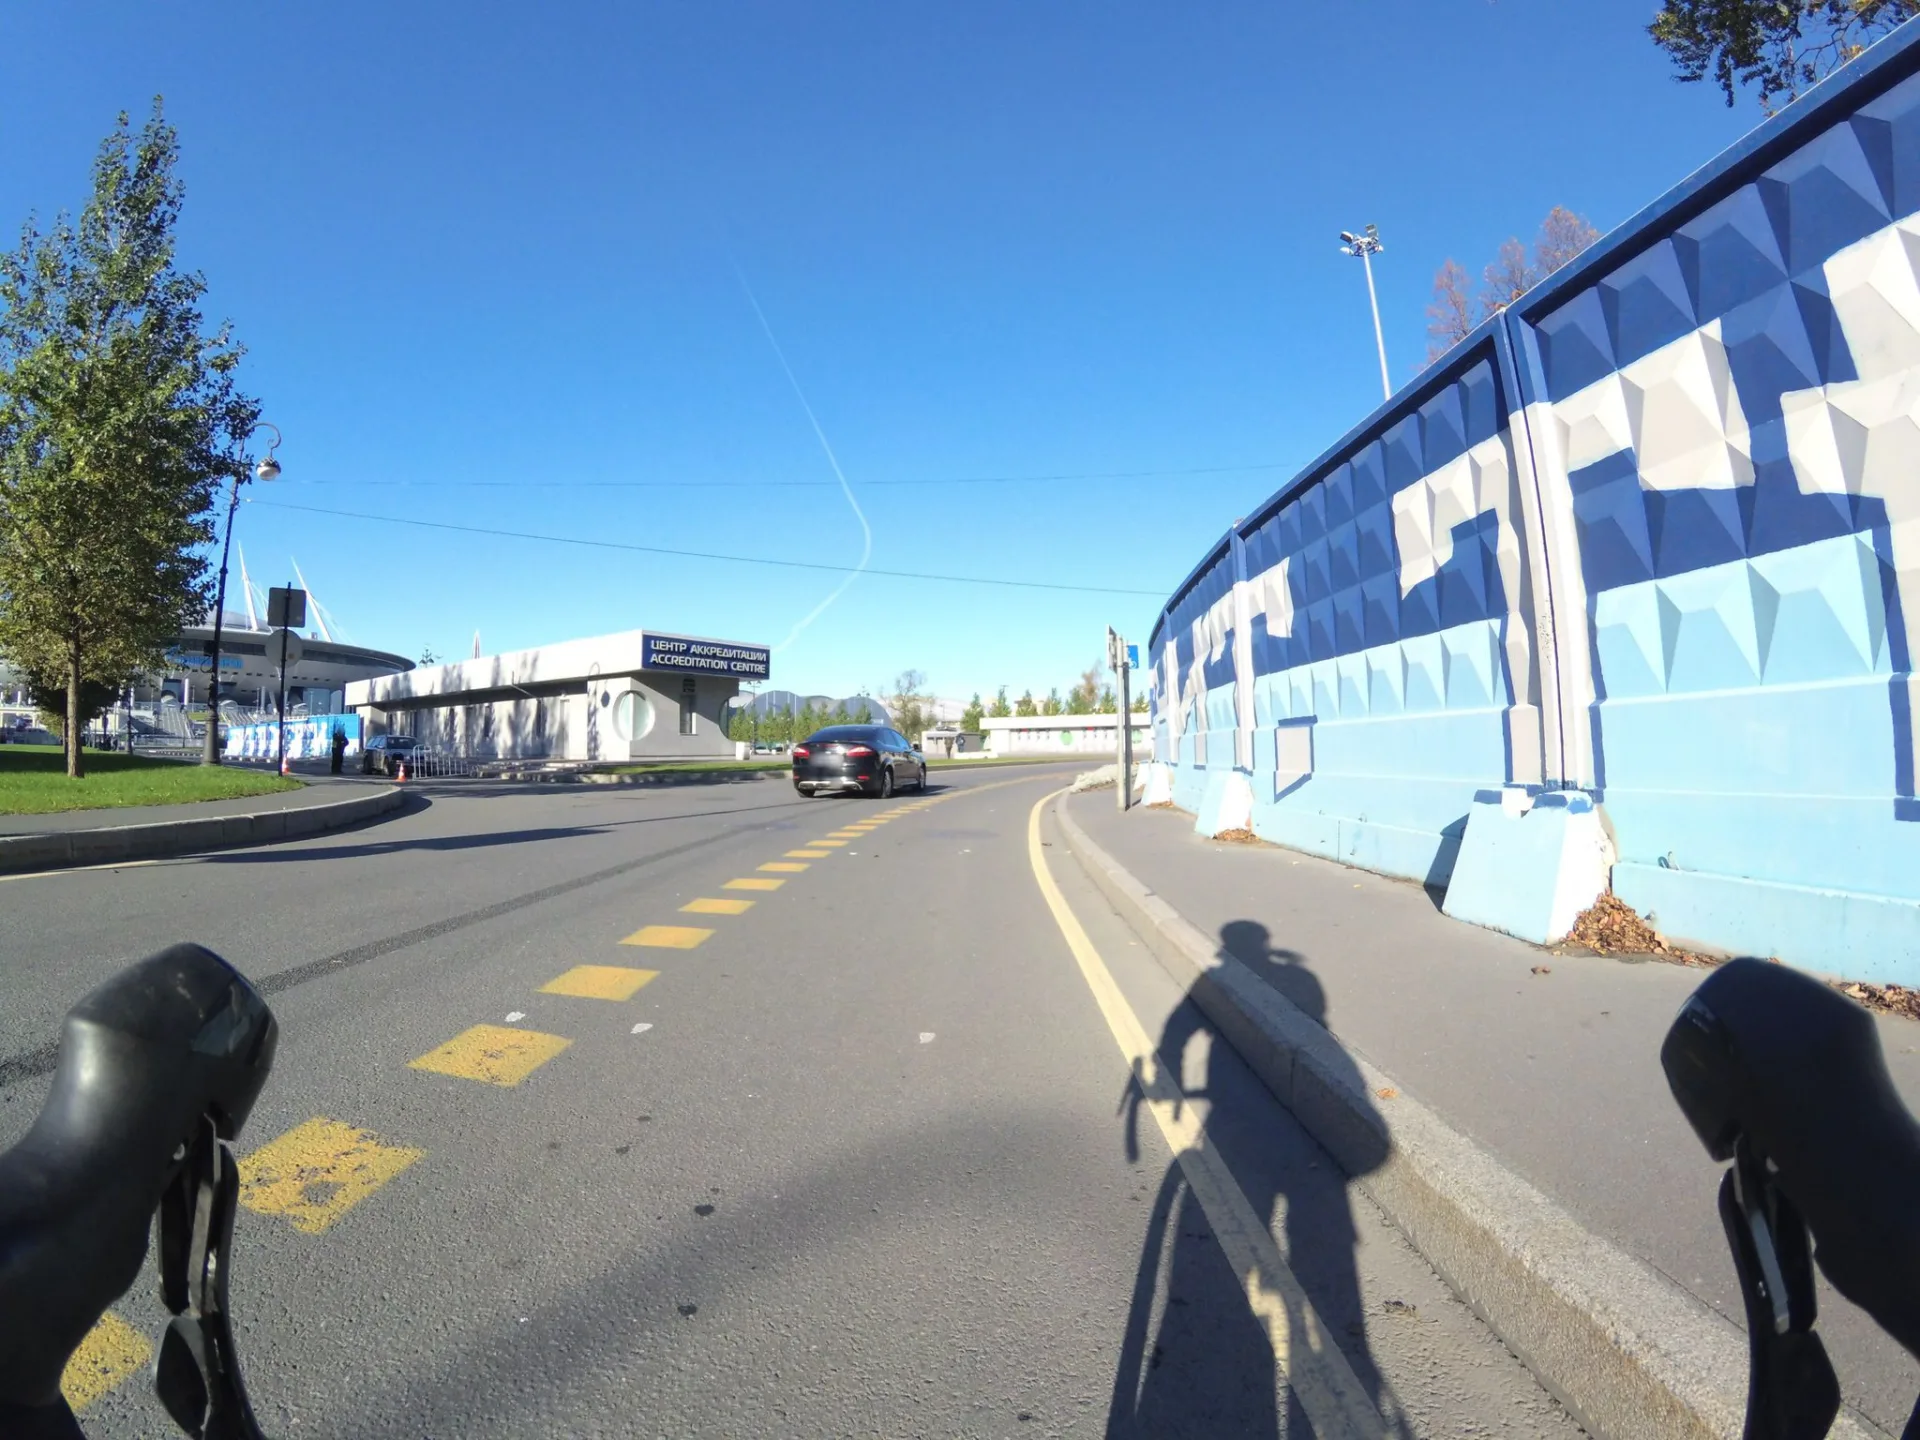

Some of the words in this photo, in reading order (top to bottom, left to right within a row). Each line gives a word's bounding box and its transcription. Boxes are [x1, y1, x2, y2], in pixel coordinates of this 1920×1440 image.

[651, 640, 687, 653] ЦЕНТР
[690, 644, 767, 661] АККРЕДИТАЦИИ
[650, 653, 728, 670] ACCREDITATION
[730, 661, 766, 674] CENTRE
